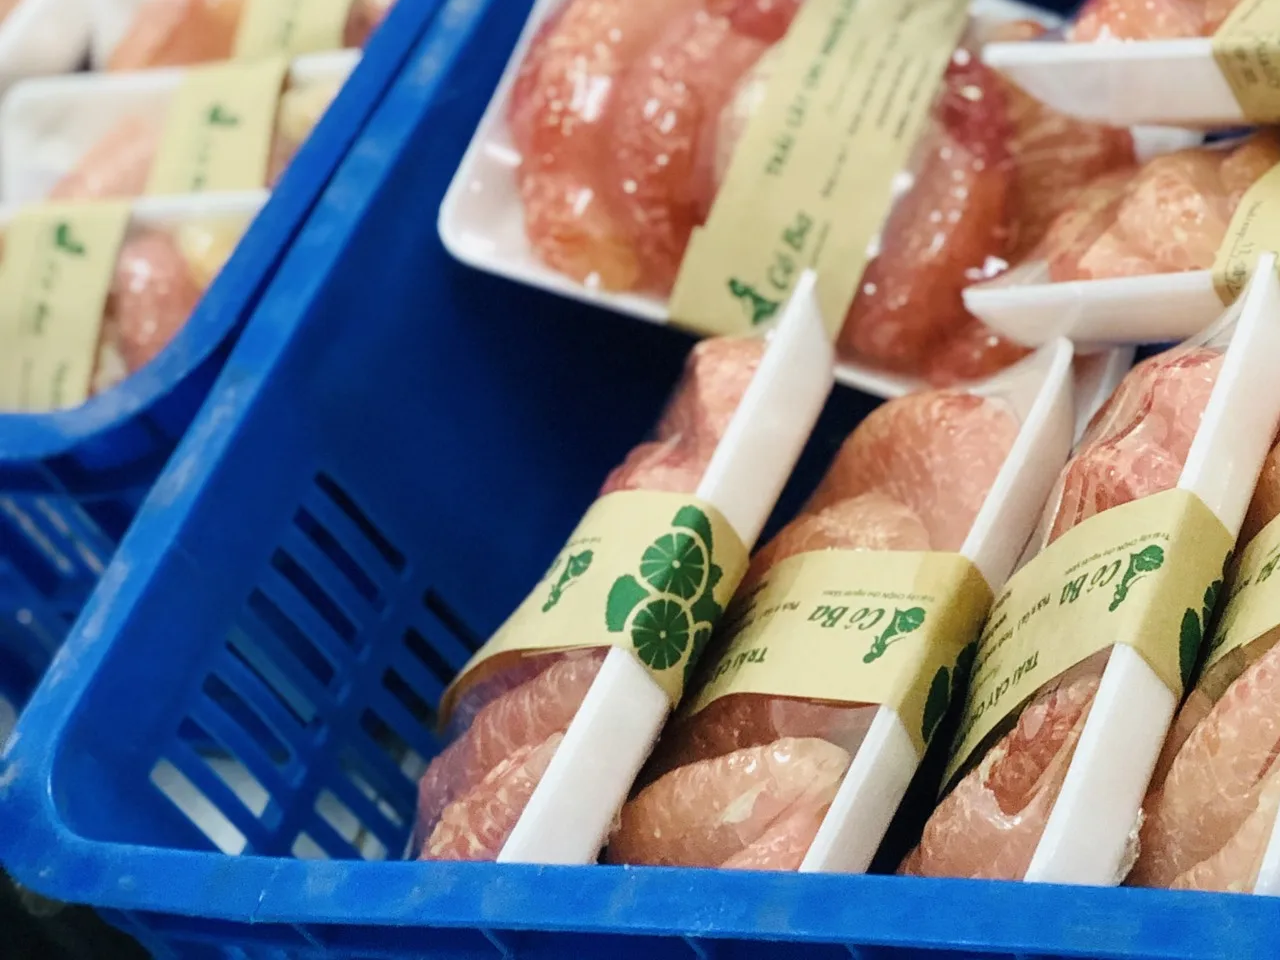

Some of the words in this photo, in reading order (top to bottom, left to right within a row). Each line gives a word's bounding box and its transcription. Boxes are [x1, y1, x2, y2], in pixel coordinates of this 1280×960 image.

[1058, 572, 1089, 606] Ba
[1086, 559, 1122, 593] Cô
[807, 605, 850, 628] Ba
[844, 607, 886, 631] Cô
[1013, 651, 1039, 686] TRÁI
